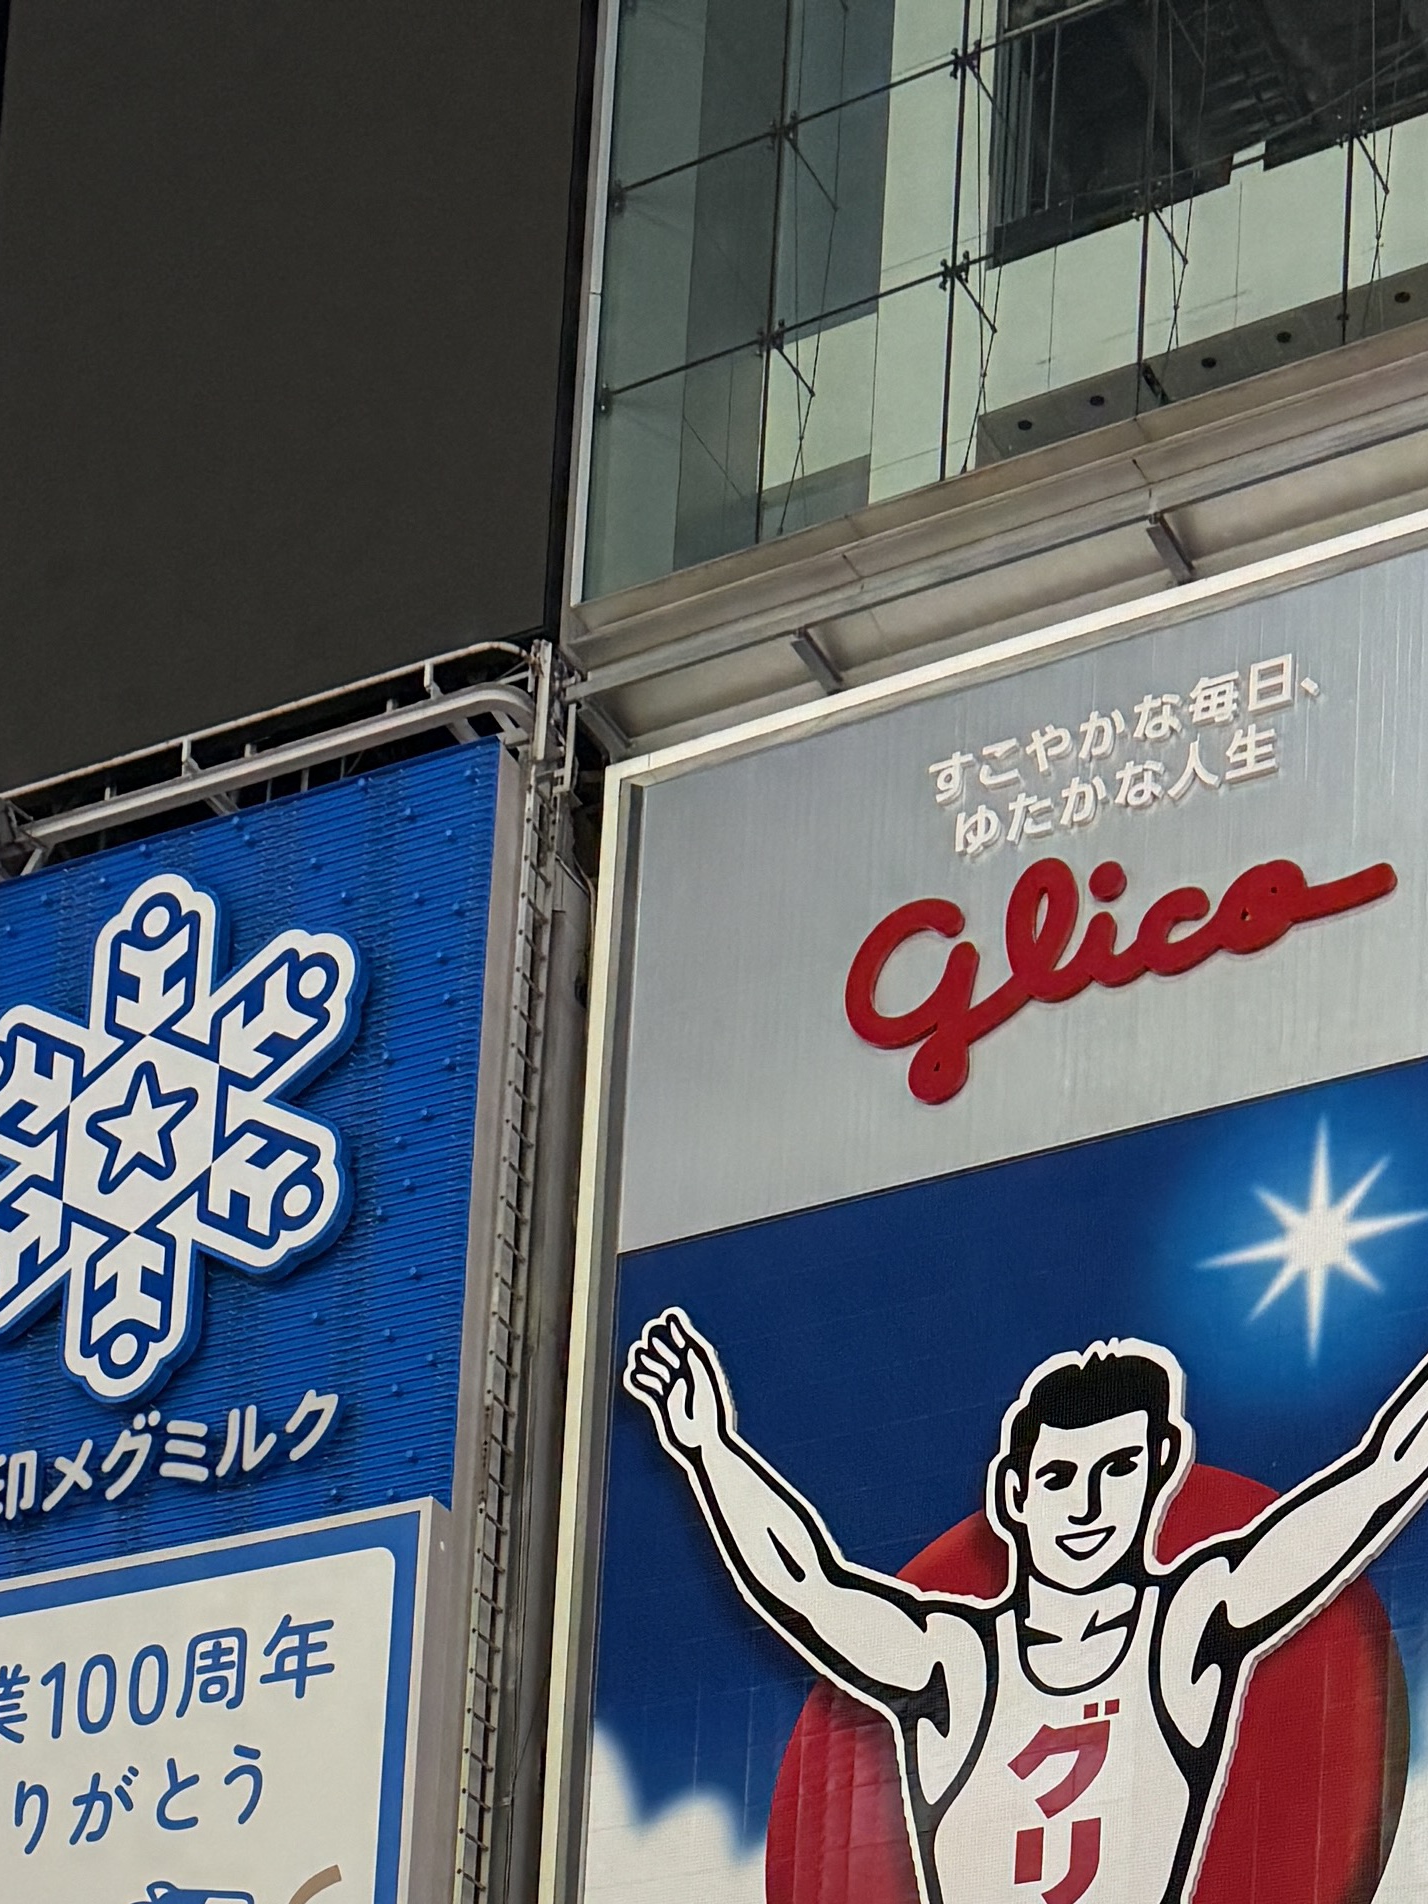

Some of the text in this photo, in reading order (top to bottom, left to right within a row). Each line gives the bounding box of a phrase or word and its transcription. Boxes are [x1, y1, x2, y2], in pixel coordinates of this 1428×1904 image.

[928, 652, 1320, 805] すこやかな毎日、
[954, 728, 1278, 857] ゆたかな人生
